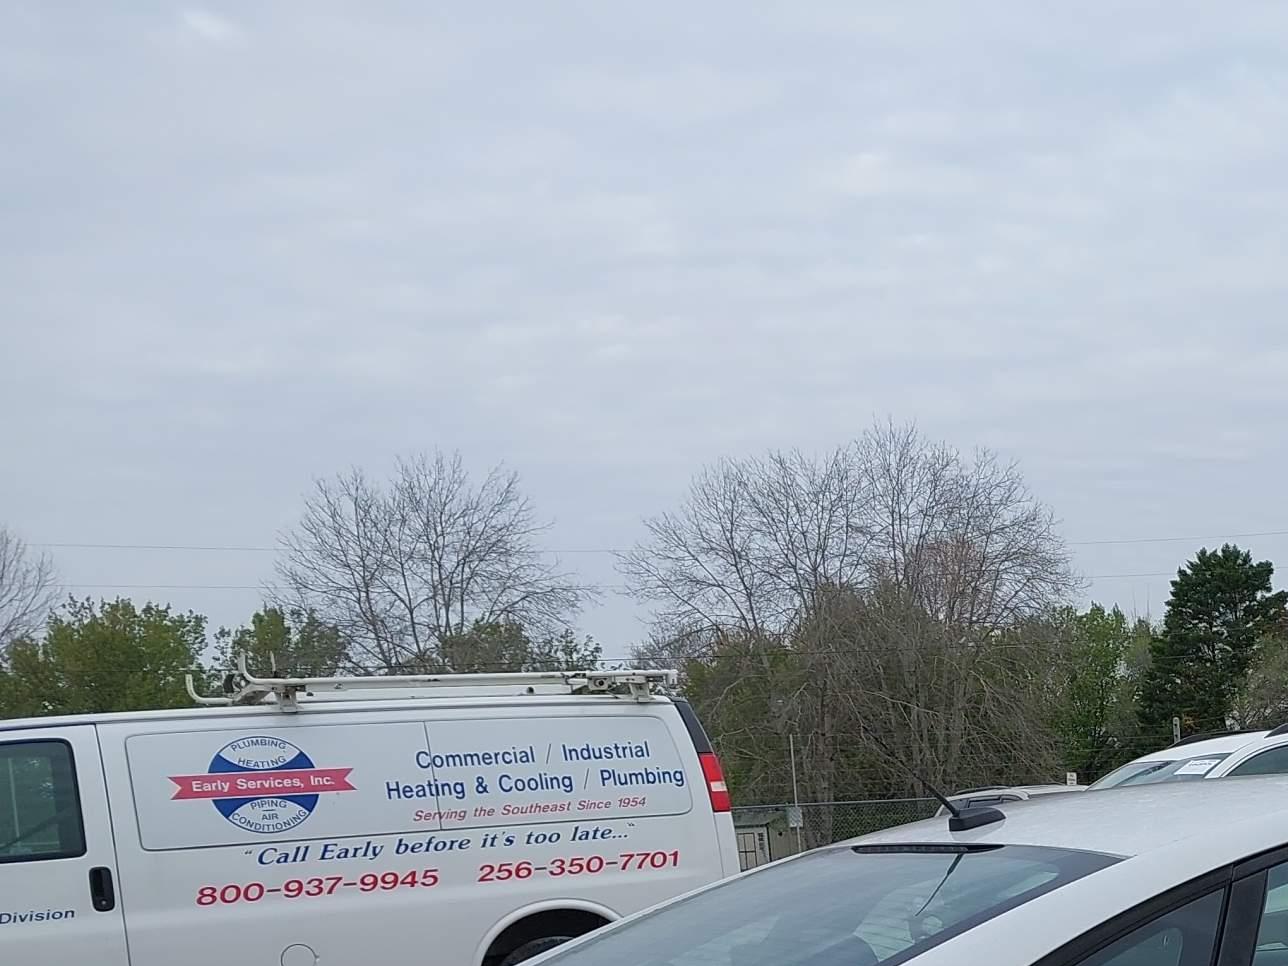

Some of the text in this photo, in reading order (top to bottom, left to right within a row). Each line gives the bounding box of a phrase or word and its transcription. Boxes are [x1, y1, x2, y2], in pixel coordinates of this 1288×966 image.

[231, 739, 287, 752] PLUMBING
[416, 746, 535, 769] Commercial
[562, 741, 650, 761] Industrial
[237, 755, 286, 770] HEATING
[192, 775, 335, 794] Early Services, Inc.
[386, 779, 466, 800] Heating
[475, 776, 489, 793] &
[498, 772, 574, 793] Cooling
[600, 767, 685, 787] Plumbing
[250, 800, 287, 811] PIPING
[413, 797, 646, 822] Serving the Southeast Since 1954
[231, 809, 307, 832] CONDITIONING
[261, 813, 279, 821] AIR
[318, 841, 384, 860] Early
[395, 836, 471, 854] before
[481, 831, 515, 848] it's
[525, 832, 561, 845] too
[196, 850, 679, 905] 800-937-9945 256-350-7701
[0, 909, 75, 924] Division
